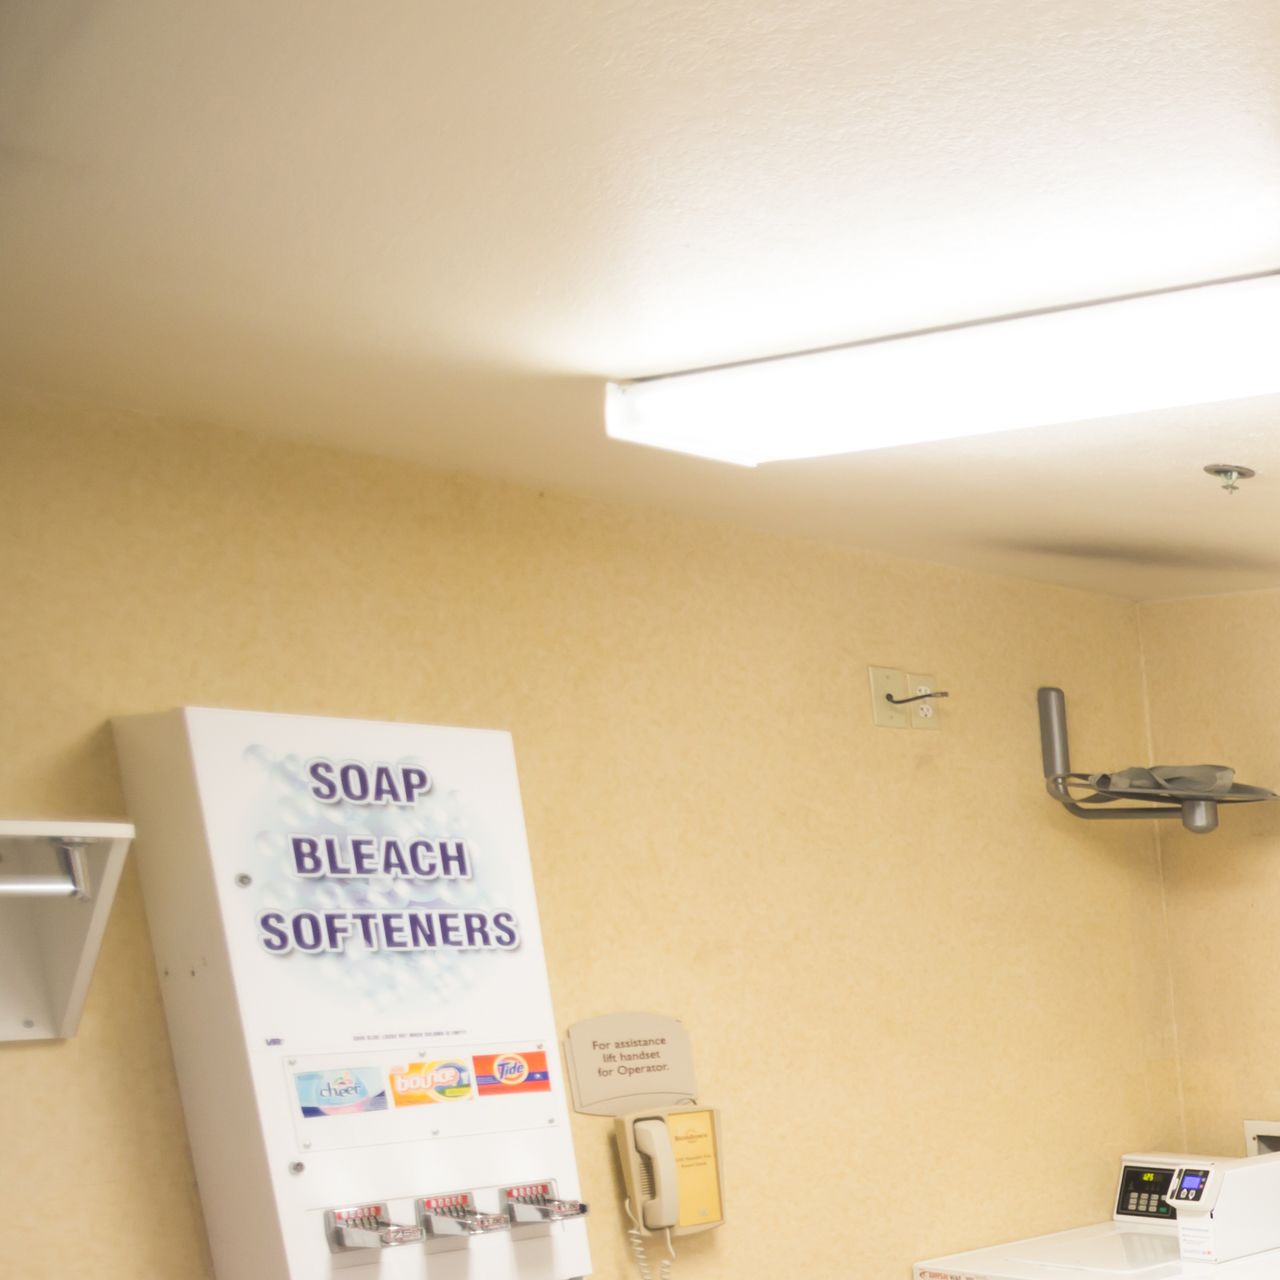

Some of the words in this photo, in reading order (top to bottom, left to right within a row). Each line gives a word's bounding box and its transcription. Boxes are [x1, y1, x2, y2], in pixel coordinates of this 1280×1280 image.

[309, 763, 428, 802] SOAP
[291, 837, 468, 876] BLEACH
[260, 912, 516, 951] SOFTENERS
[592, 1040, 612, 1051] For
[614, 1037, 667, 1049] assistance
[602, 1053, 617, 1064] lift
[619, 1050, 661, 1062] handset
[396, 1066, 458, 1093] bounce
[497, 1059, 524, 1080] Tide
[617, 1063, 670, 1077] Operator.
[320, 1079, 361, 1098] cheer
